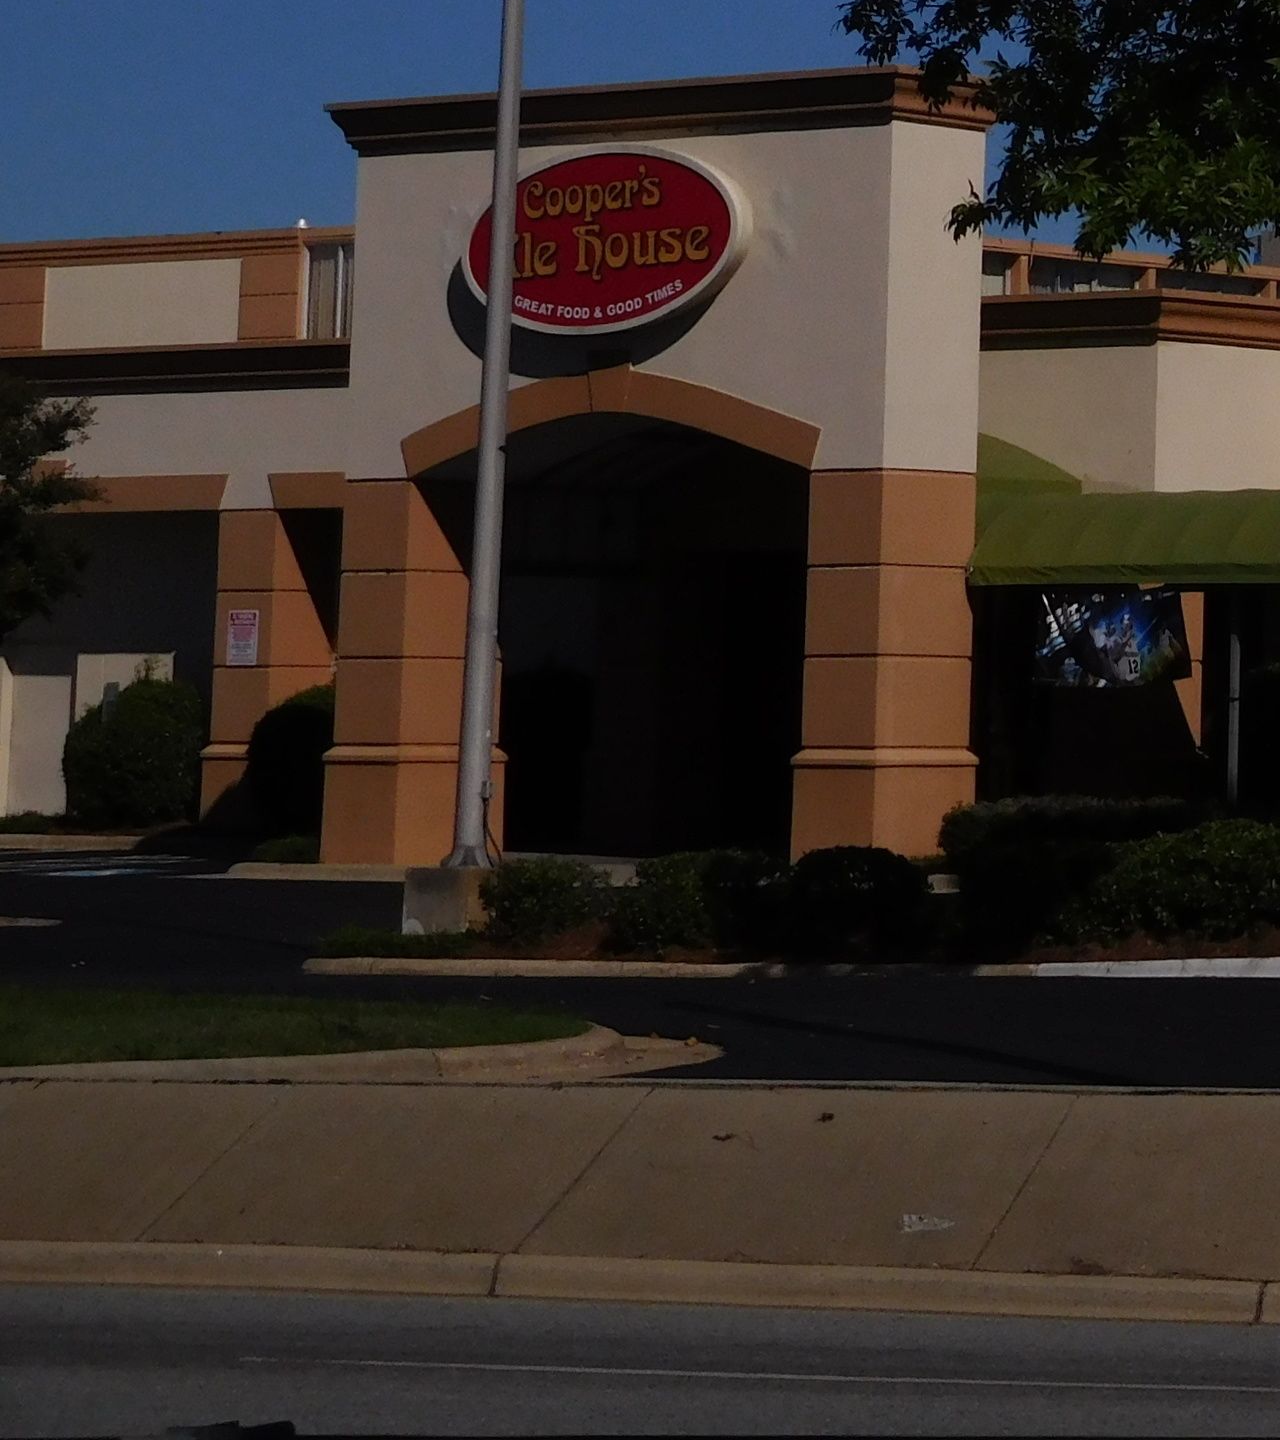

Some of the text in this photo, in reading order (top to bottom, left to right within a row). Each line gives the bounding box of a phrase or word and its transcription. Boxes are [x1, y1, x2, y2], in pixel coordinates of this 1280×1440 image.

[523, 164, 661, 222] Cooper's
[512, 231, 558, 278] le
[514, 279, 683, 320] GREAT FOOD & GOOD TIMES
[1128, 659, 1139, 674] 12
